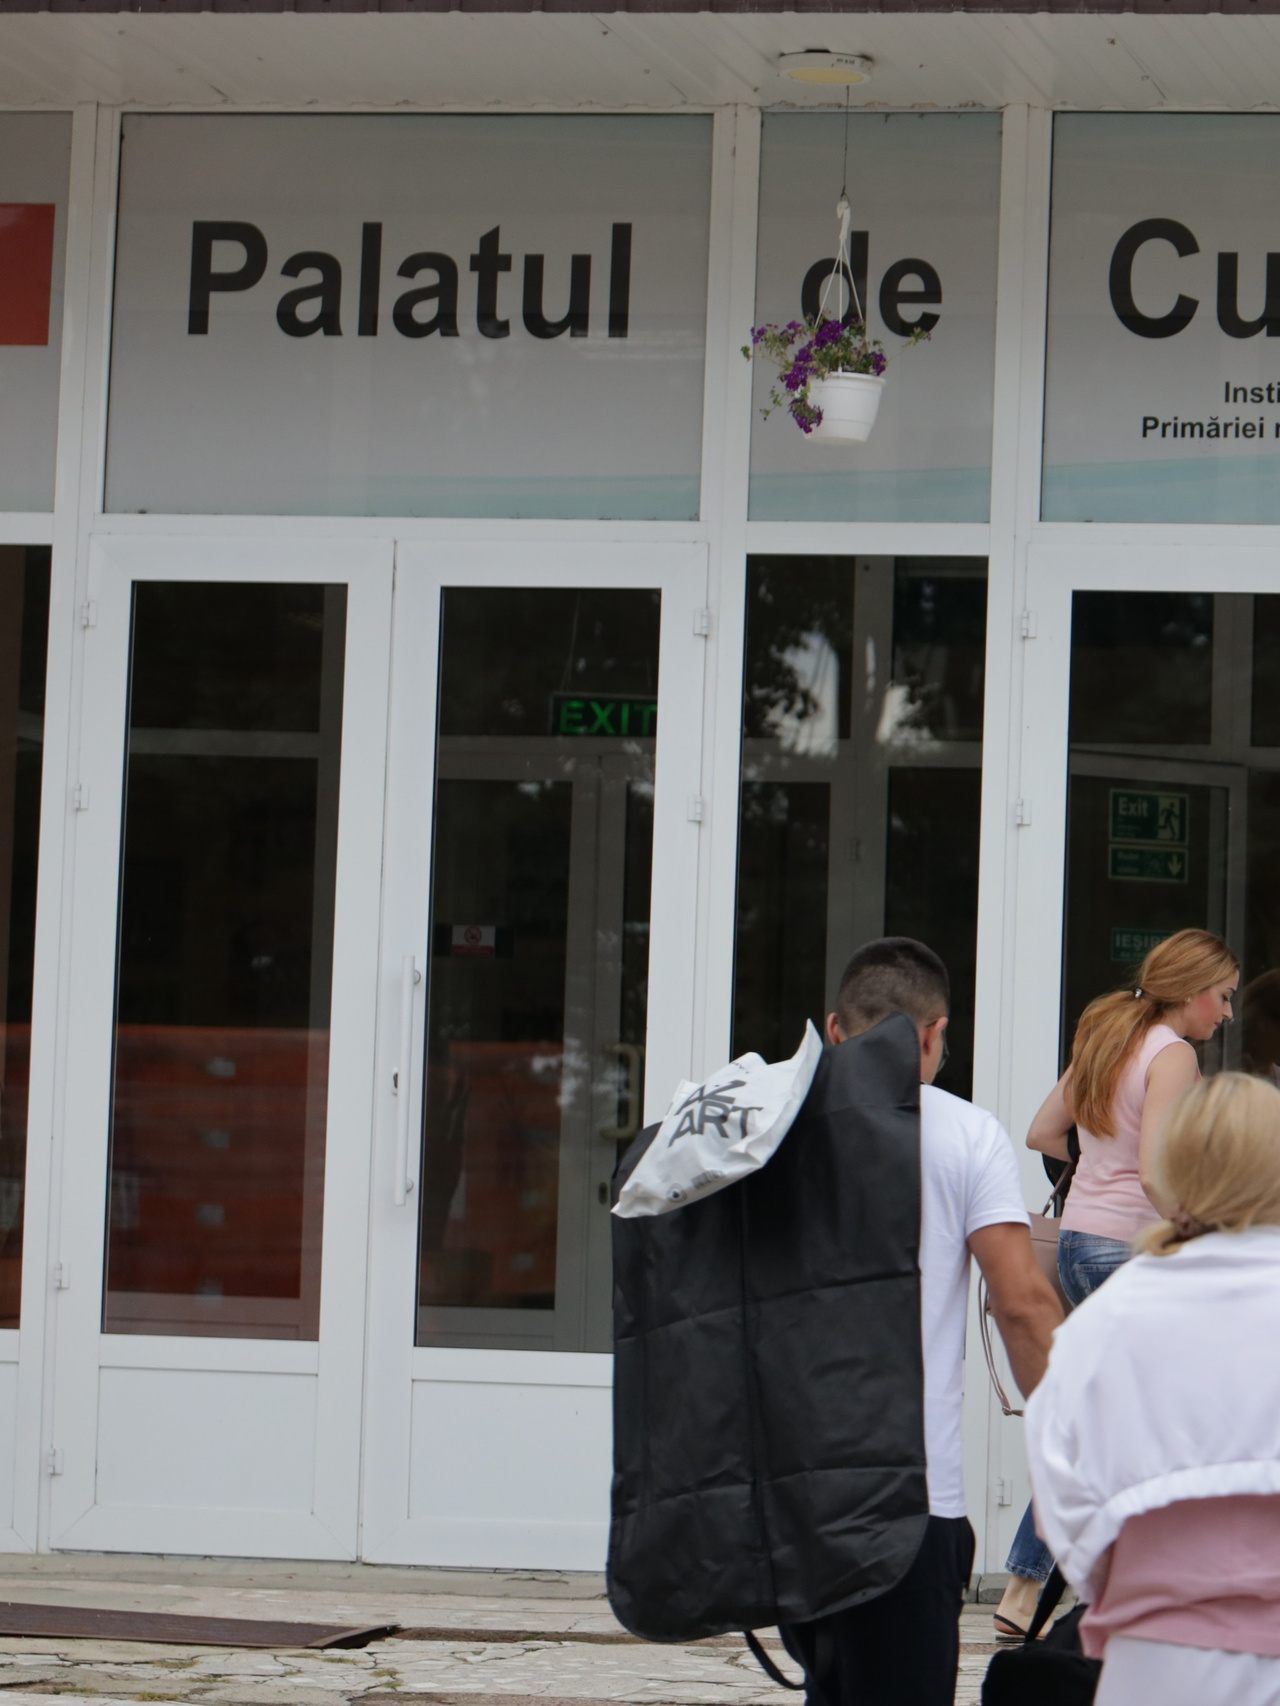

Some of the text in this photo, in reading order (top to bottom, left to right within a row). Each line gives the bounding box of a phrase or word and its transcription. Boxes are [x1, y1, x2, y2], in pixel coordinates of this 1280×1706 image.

[188, 221, 633, 339] Palatul
[802, 231, 943, 338] de
[1143, 417, 1265, 439] Primăriei
[560, 701, 659, 735] EXIT
[1118, 796, 1149, 817] Exit
[667, 1100, 764, 1148] ART
